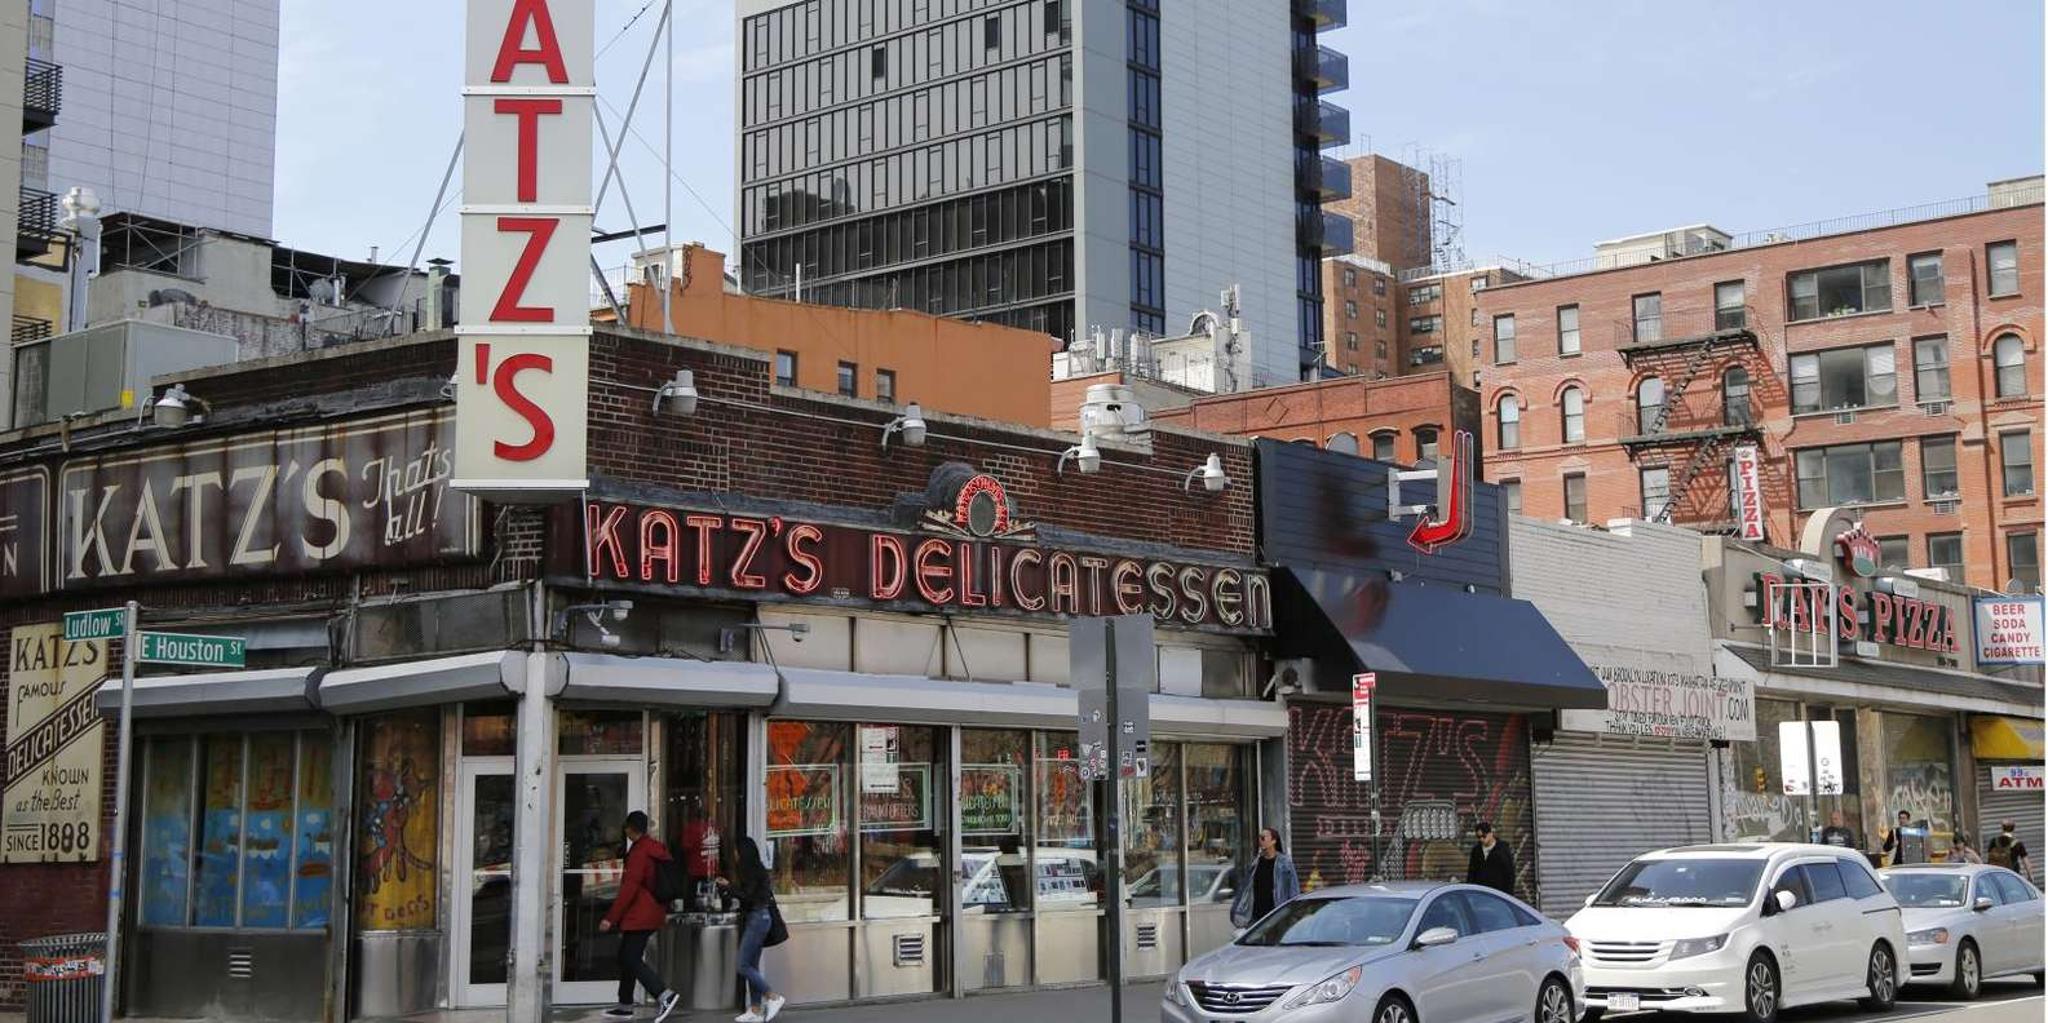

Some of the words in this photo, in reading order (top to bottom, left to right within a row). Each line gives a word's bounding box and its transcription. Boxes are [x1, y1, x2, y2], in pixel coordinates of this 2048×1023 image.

[361, 440, 451, 509] That's
[1739, 461, 1760, 537] PIZZA
[67, 458, 351, 579] KATZ'S
[588, 504, 823, 594] KATZ'S
[872, 533, 1272, 629] DELICATESSEN
[1762, 572, 1859, 640] RAYS
[1872, 592, 1960, 654] PIZZA
[1993, 604, 2025, 616] BEER
[65, 614, 111, 638] Ludlow
[1993, 619, 2026, 630] SODA
[141, 636, 149, 658] E
[156, 636, 224, 662] Houston
[230, 641, 242, 655] St
[1991, 632, 2031, 644] CANDY
[1983, 645, 2041, 659] CIGARETTE
[42, 768, 89, 785] KNOWN
[1999, 777, 2043, 788] ATM
[16, 798, 28, 812] as
[32, 793, 49, 811] the
[50, 789, 80, 811] Best
[7, 835, 38, 852] SINCE
